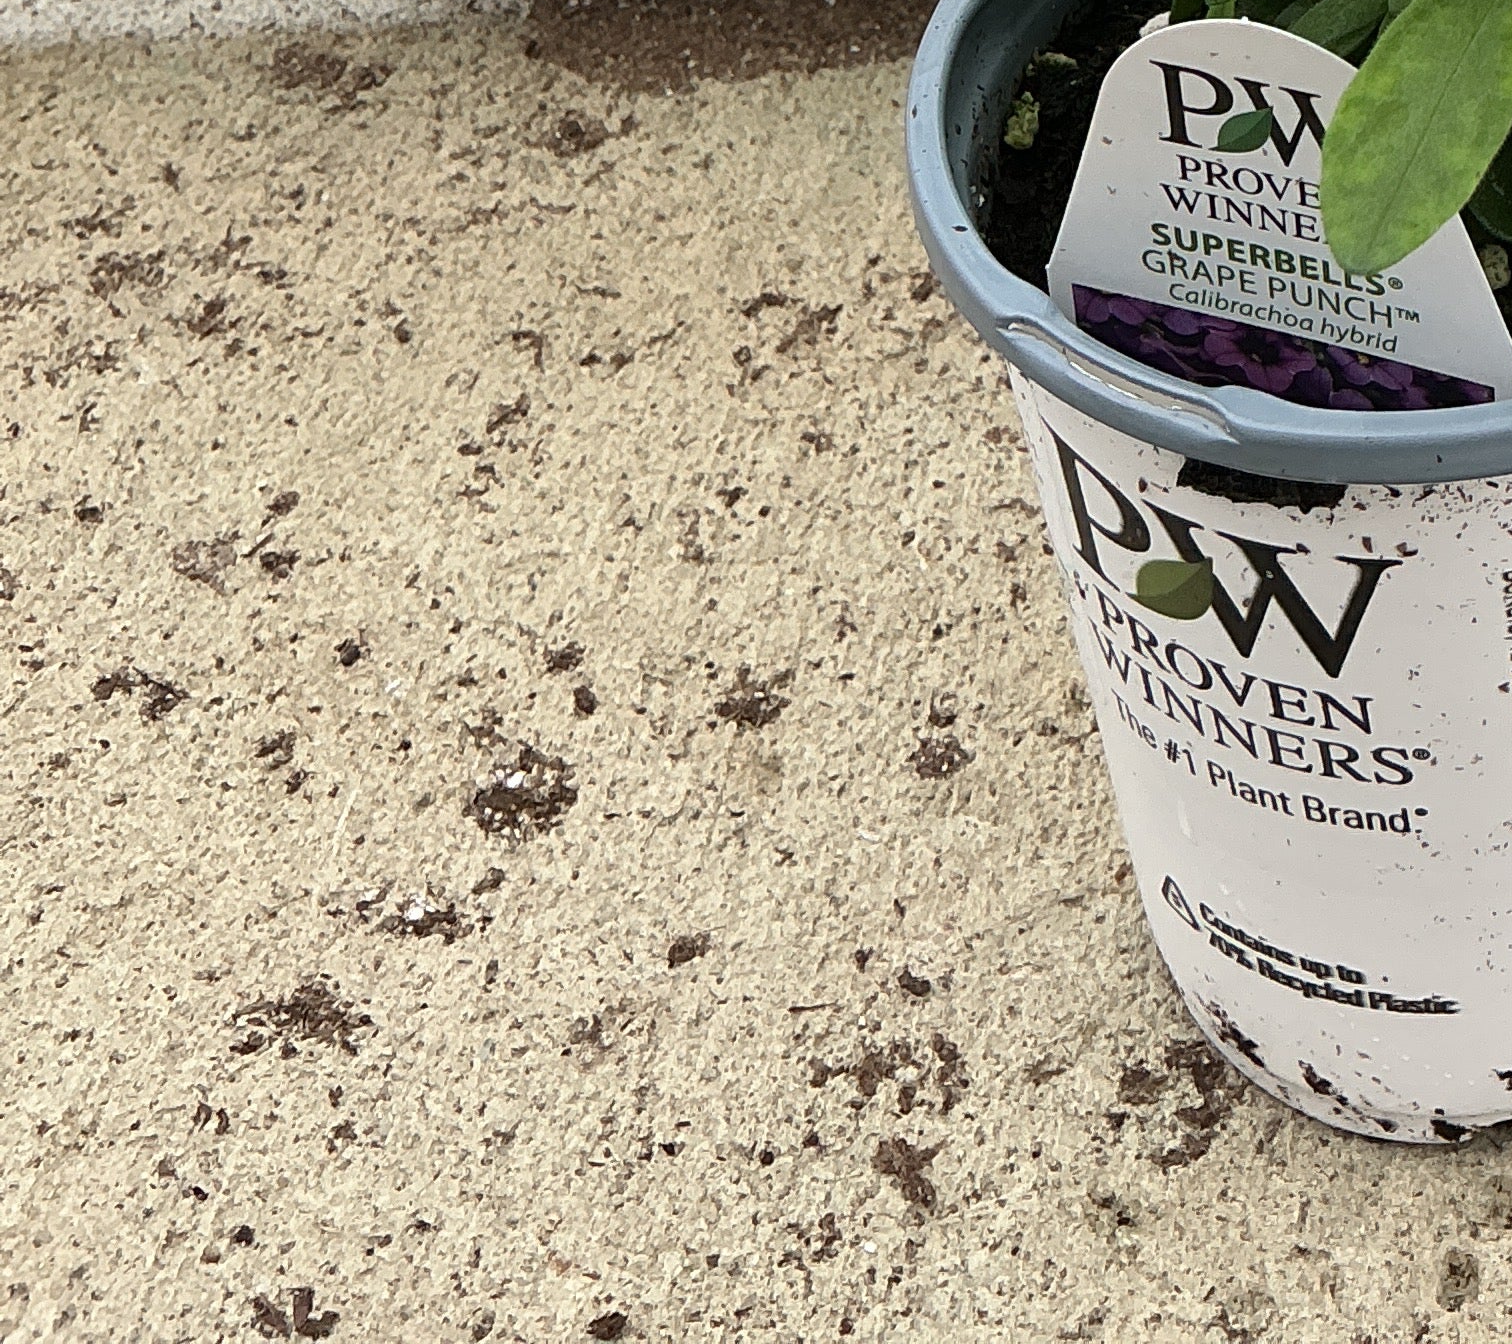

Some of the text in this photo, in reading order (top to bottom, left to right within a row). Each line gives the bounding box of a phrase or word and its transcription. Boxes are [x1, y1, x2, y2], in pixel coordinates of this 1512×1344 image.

[1158, 182, 1329, 245] WINNE
[1176, 153, 1321, 210] PROVE
[1142, 249, 1258, 295] GRAPE
[1169, 283, 1398, 354] Calibrachoa hybrid
[1040, 414, 1404, 679] PW
[1093, 583, 1374, 735] PROVEN
[1111, 688, 1158, 752] The
[1164, 738, 1196, 776] #1
[1206, 758, 1296, 817] Plant
[1199, 901, 1367, 985] Contains up to
[1257, 956, 1367, 1008] Recycled
[1368, 990, 1461, 1014] Plastic
